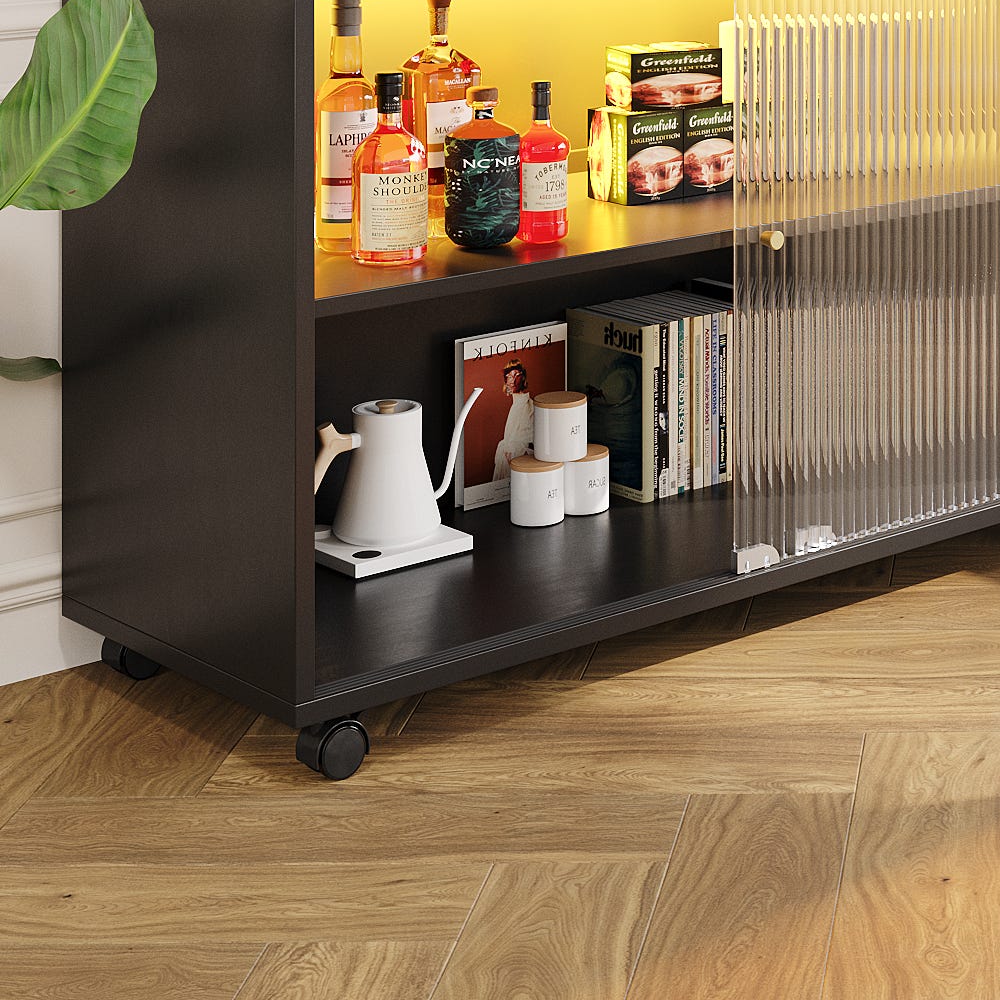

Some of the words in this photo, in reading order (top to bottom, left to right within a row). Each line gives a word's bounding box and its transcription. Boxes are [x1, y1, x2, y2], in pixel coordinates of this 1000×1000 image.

[640, 53, 714, 67] Greenfield
[679, 64, 719, 72] EDITION
[688, 110, 732, 128] Greenfield
[632, 117, 677, 135] Greenfield
[630, 137, 655, 145] ENGLISH
[655, 132, 681, 141] EDITION
[687, 129, 711, 137] ENGLISH
[545, 180, 565, 192] 1798
[712, 342, 718, 352] IN
[679, 405, 685, 413] IN
